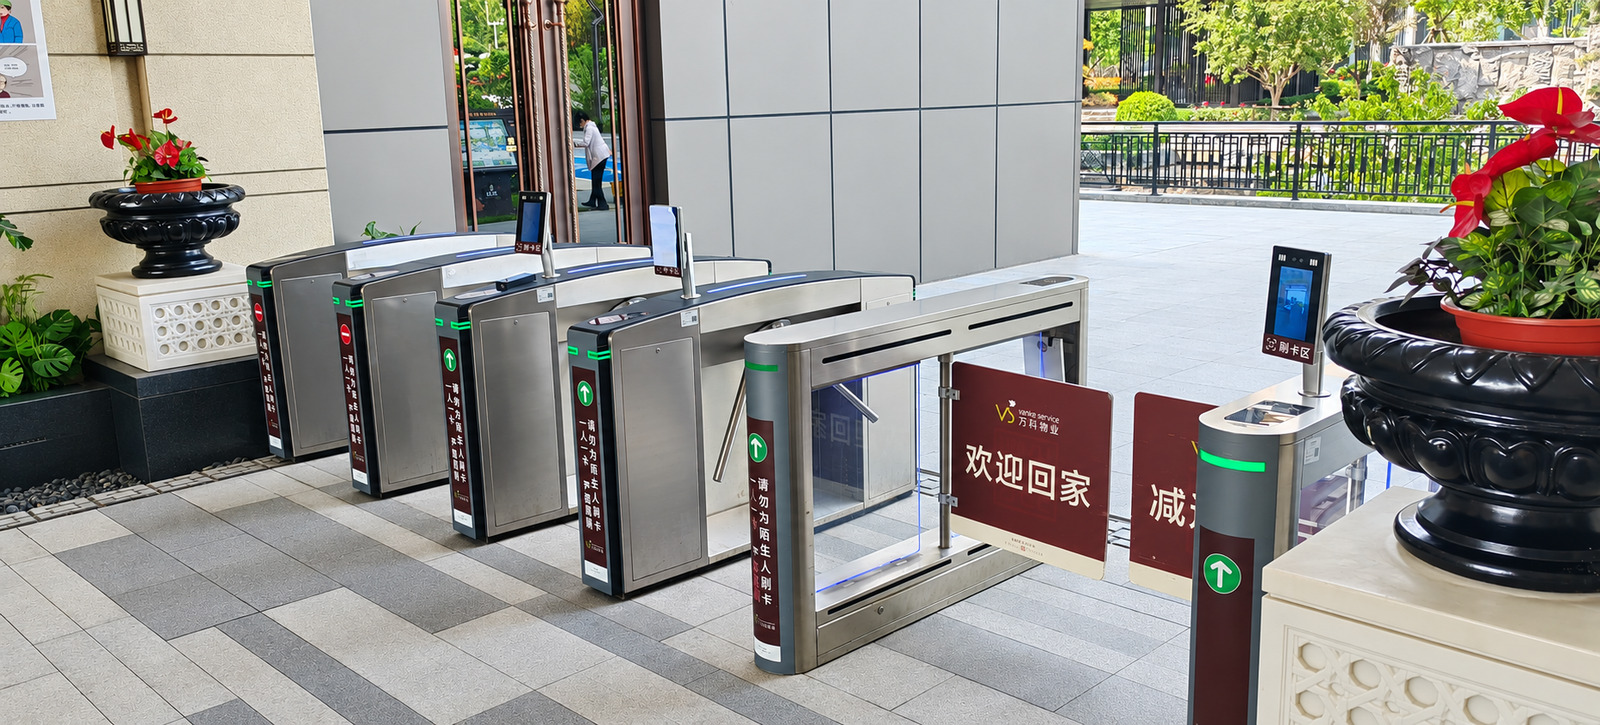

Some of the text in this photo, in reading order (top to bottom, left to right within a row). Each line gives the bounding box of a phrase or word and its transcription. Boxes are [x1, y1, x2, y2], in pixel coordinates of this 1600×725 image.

[1278, 341, 1311, 360] 刷卡区
[1018, 409, 1060, 424] vanke service
[1018, 416, 1059, 436] 万科物业
[965, 444, 1091, 508] 欢迎回家
[757, 477, 772, 606] 请勿为陌生人刷卡
